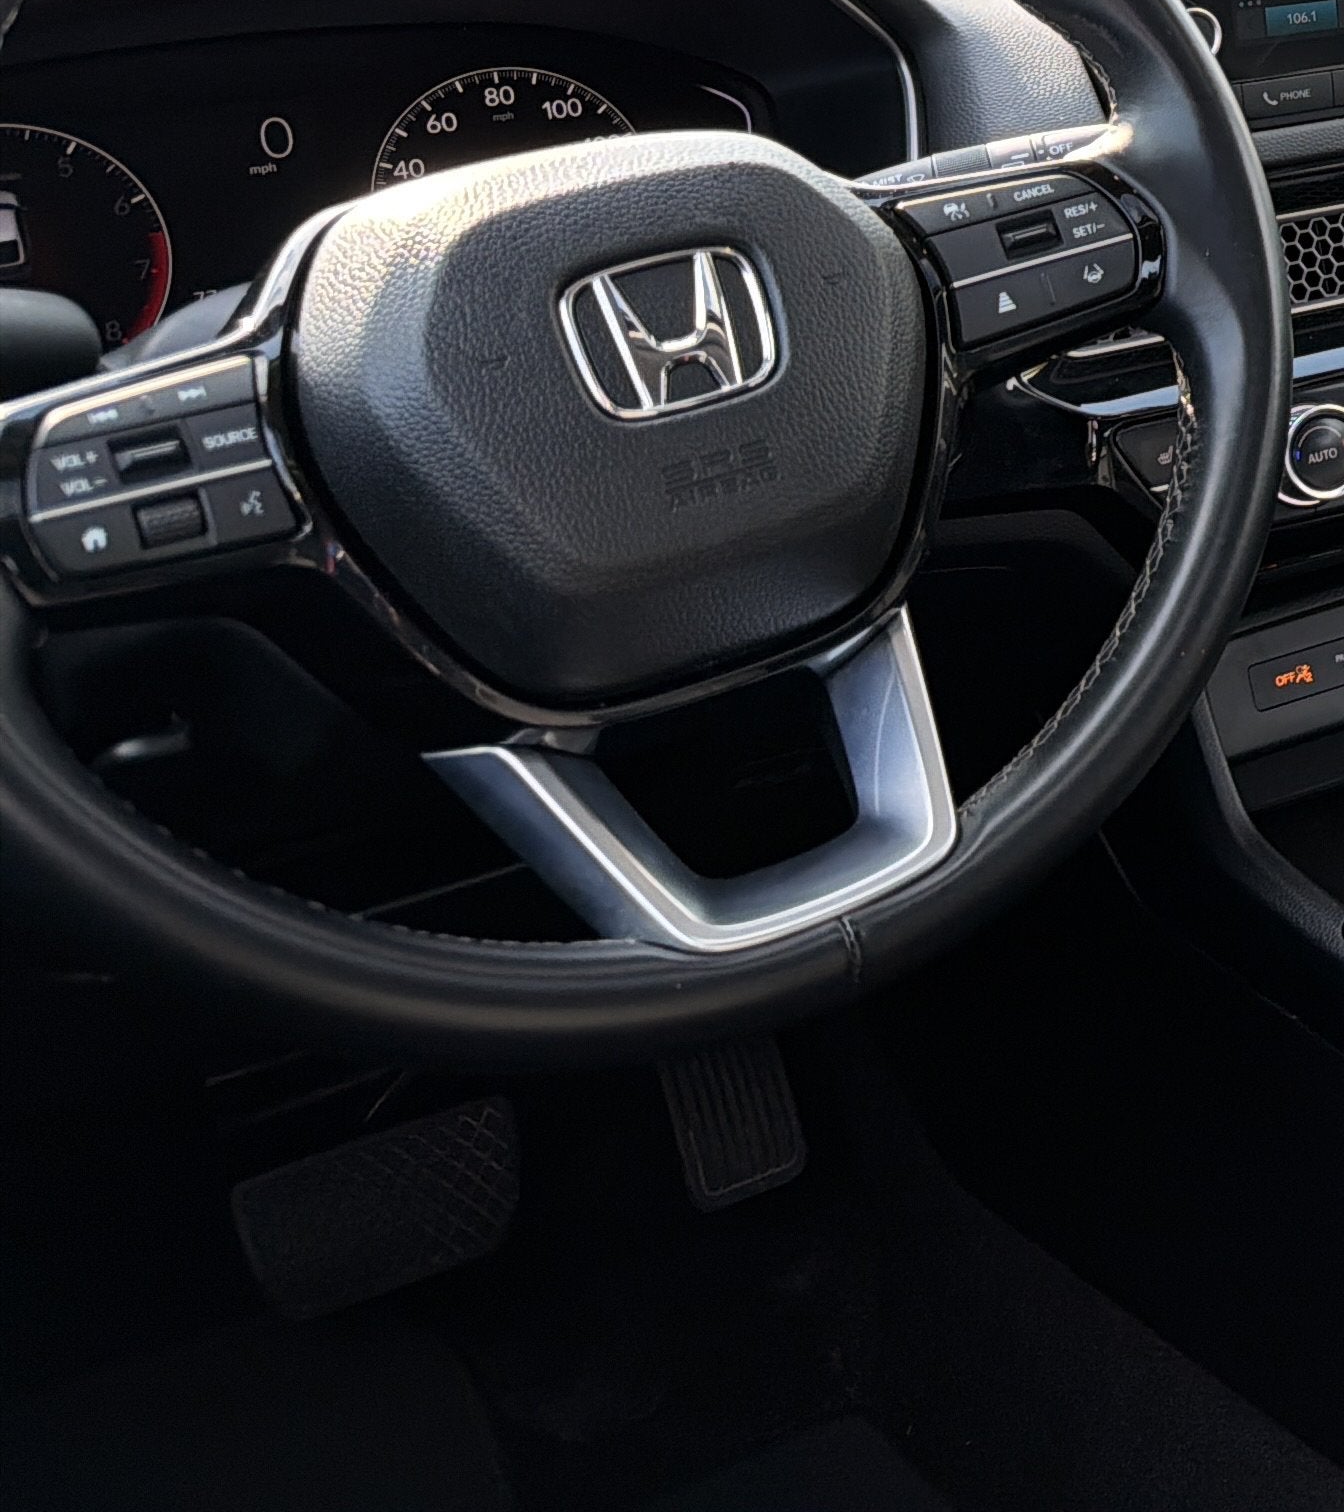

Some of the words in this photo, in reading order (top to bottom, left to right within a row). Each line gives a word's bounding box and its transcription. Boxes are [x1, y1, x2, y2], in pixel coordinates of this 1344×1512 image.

[1286, 10, 1318, 26] 106.1
[483, 85, 516, 108] 80
[1280, 87, 1312, 103] PHONE
[492, 111, 514, 122] mph
[541, 97, 583, 121] 100
[425, 112, 458, 134] 60
[260, 116, 294, 159] 0
[1050, 142, 1074, 156] OFF
[57, 158, 74, 178] 5
[248, 162, 278, 176] mph
[393, 157, 425, 180] 40
[1013, 184, 1055, 202] CANCEL
[114, 195, 130, 216] 6
[134, 259, 150, 280] 7
[105, 320, 123, 341] 8
[202, 427, 258, 451] SOURCE
[1307, 445, 1339, 466] AUTO
[1275, 671, 1296, 688] OFF
